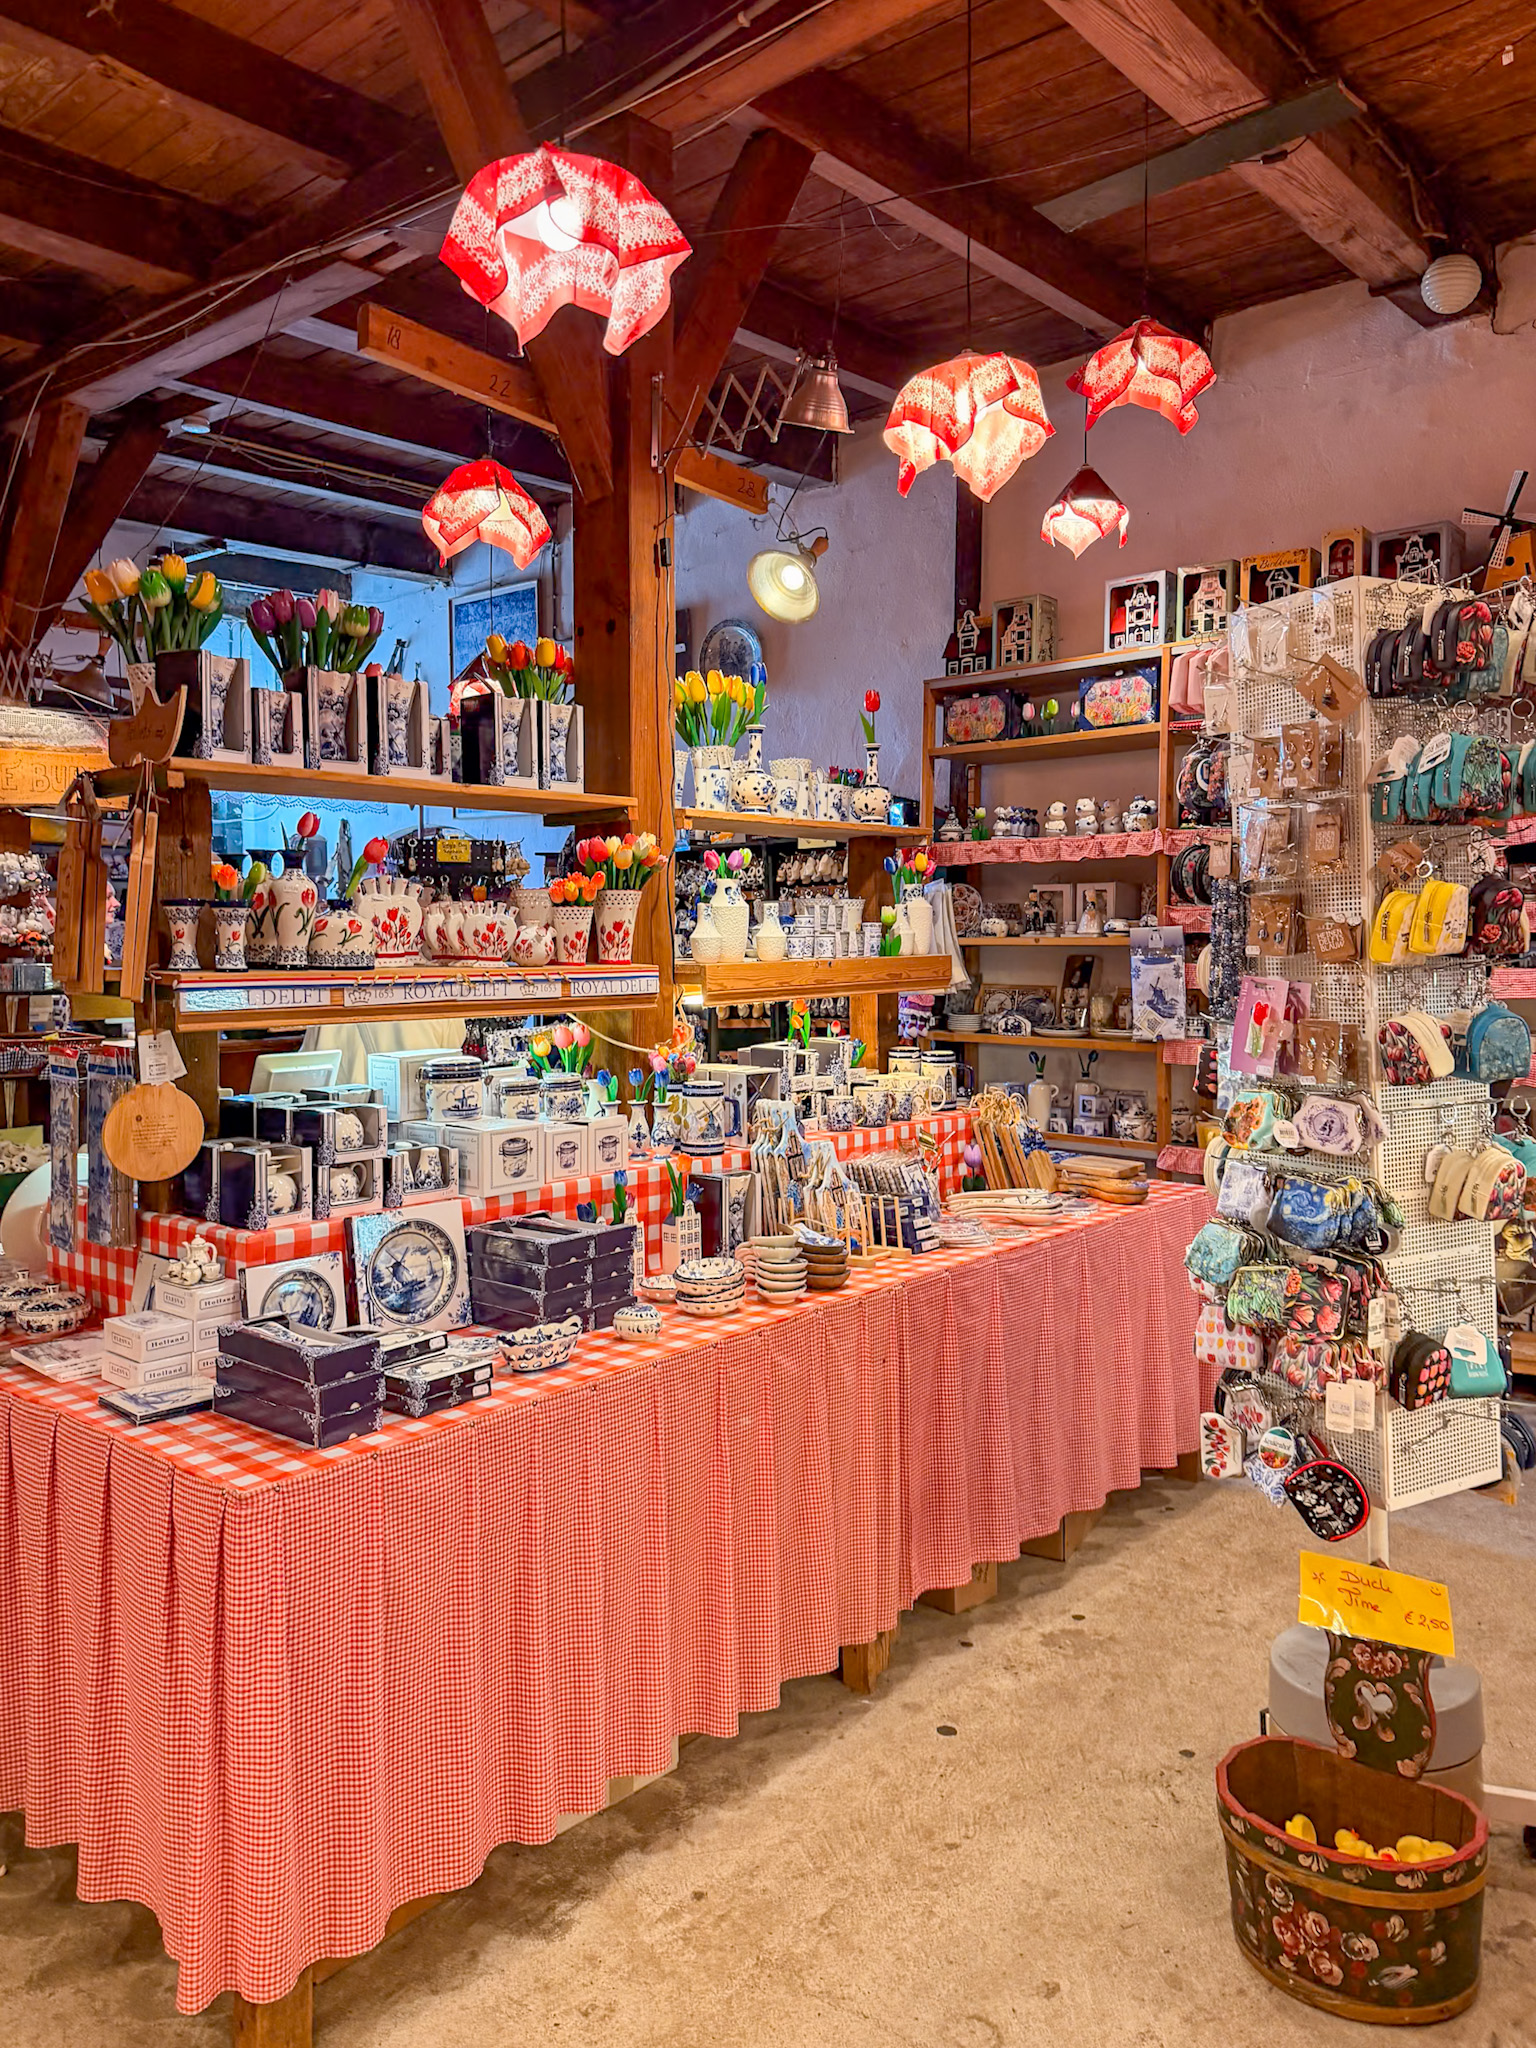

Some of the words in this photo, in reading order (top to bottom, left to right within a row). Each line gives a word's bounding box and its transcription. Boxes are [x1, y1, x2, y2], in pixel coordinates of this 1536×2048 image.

[387, 325, 401, 350] 18
[489, 374, 511, 398] 22
[737, 477, 756, 498] 28
[262, 987, 325, 1005] DELFT
[373, 986, 394, 999] 1653
[540, 983, 557, 993] 1653
[573, 980, 613, 995] ROYAL
[203, 1295, 237, 1307] Holland
[151, 1335, 185, 1348] Holland
[149, 1366, 184, 1379] Holland
[1338, 1569, 1393, 1594] Duck
[1337, 1586, 1383, 1613] Time
